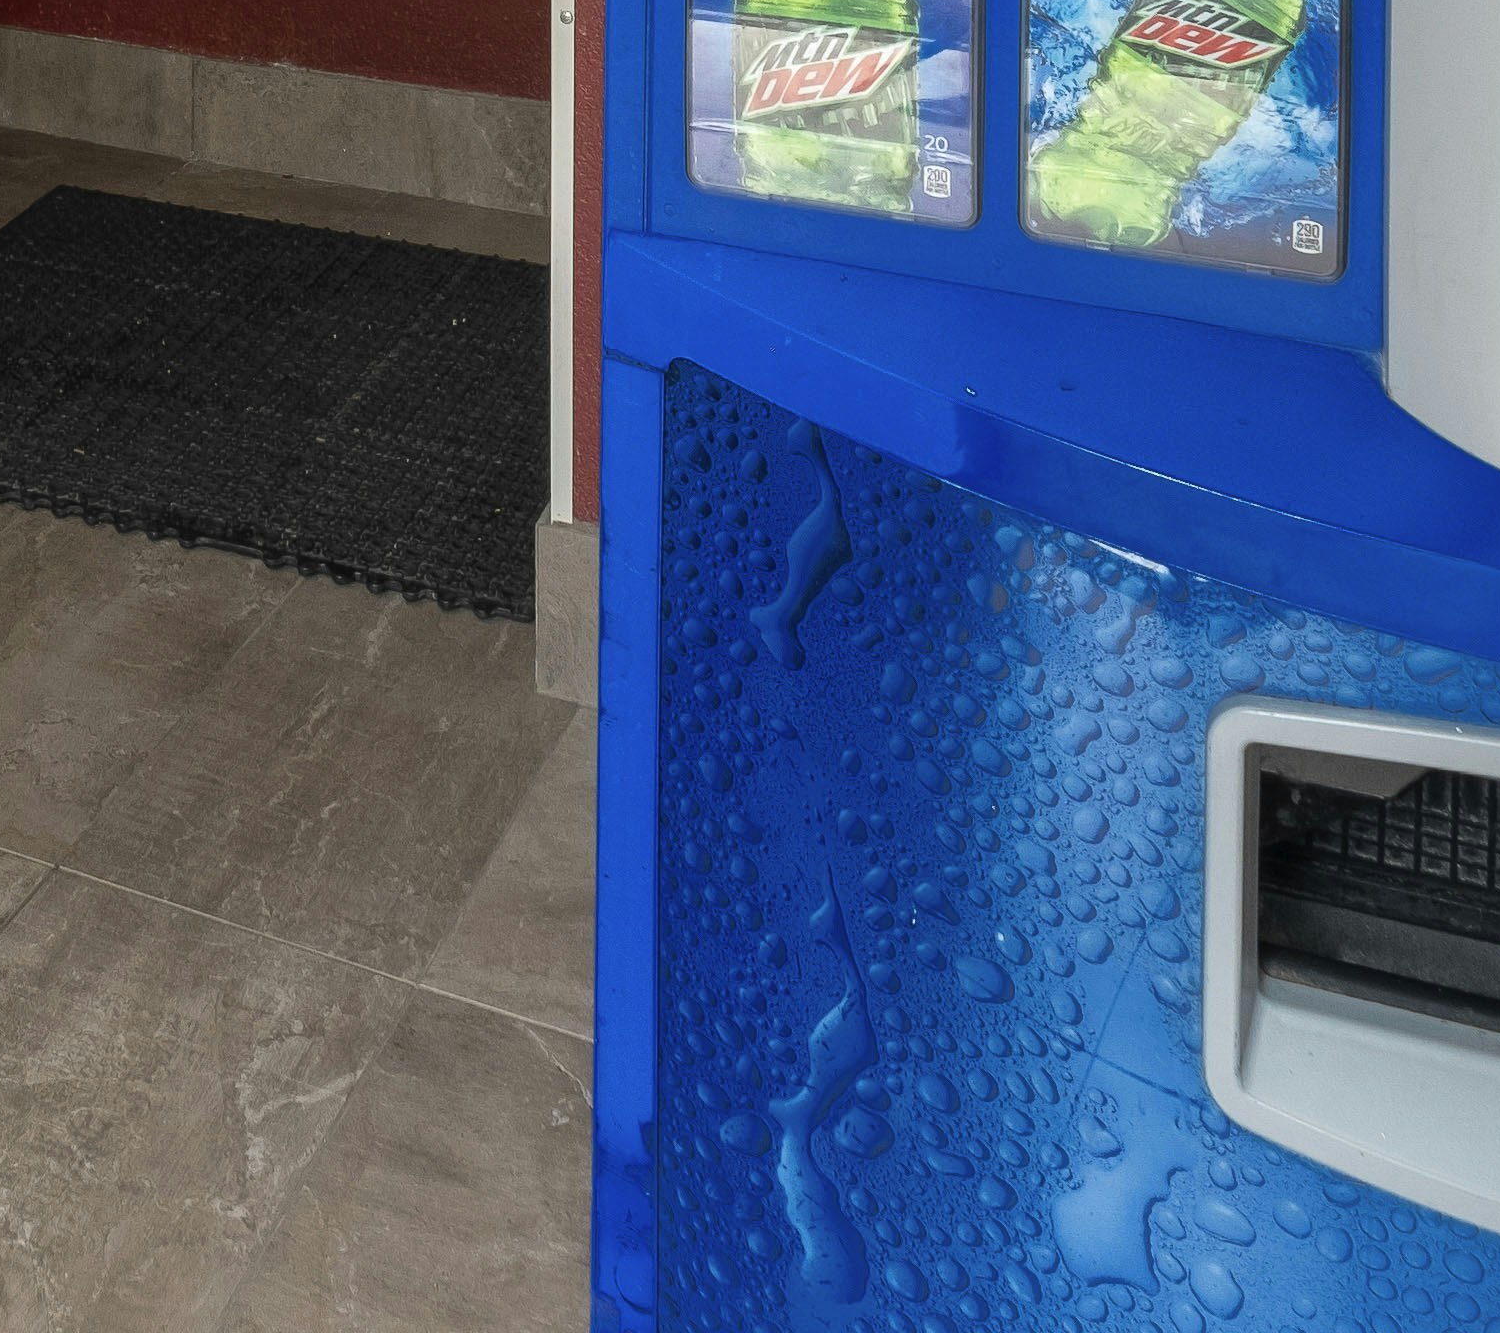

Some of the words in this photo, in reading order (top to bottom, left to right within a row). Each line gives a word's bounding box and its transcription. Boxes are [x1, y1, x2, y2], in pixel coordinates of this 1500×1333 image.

[1158, 0, 1243, 33] Mtn
[755, 30, 850, 77] Mtn
[1123, 18, 1290, 65] DEW
[745, 42, 908, 110] DEW
[923, 135, 949, 152] 20
